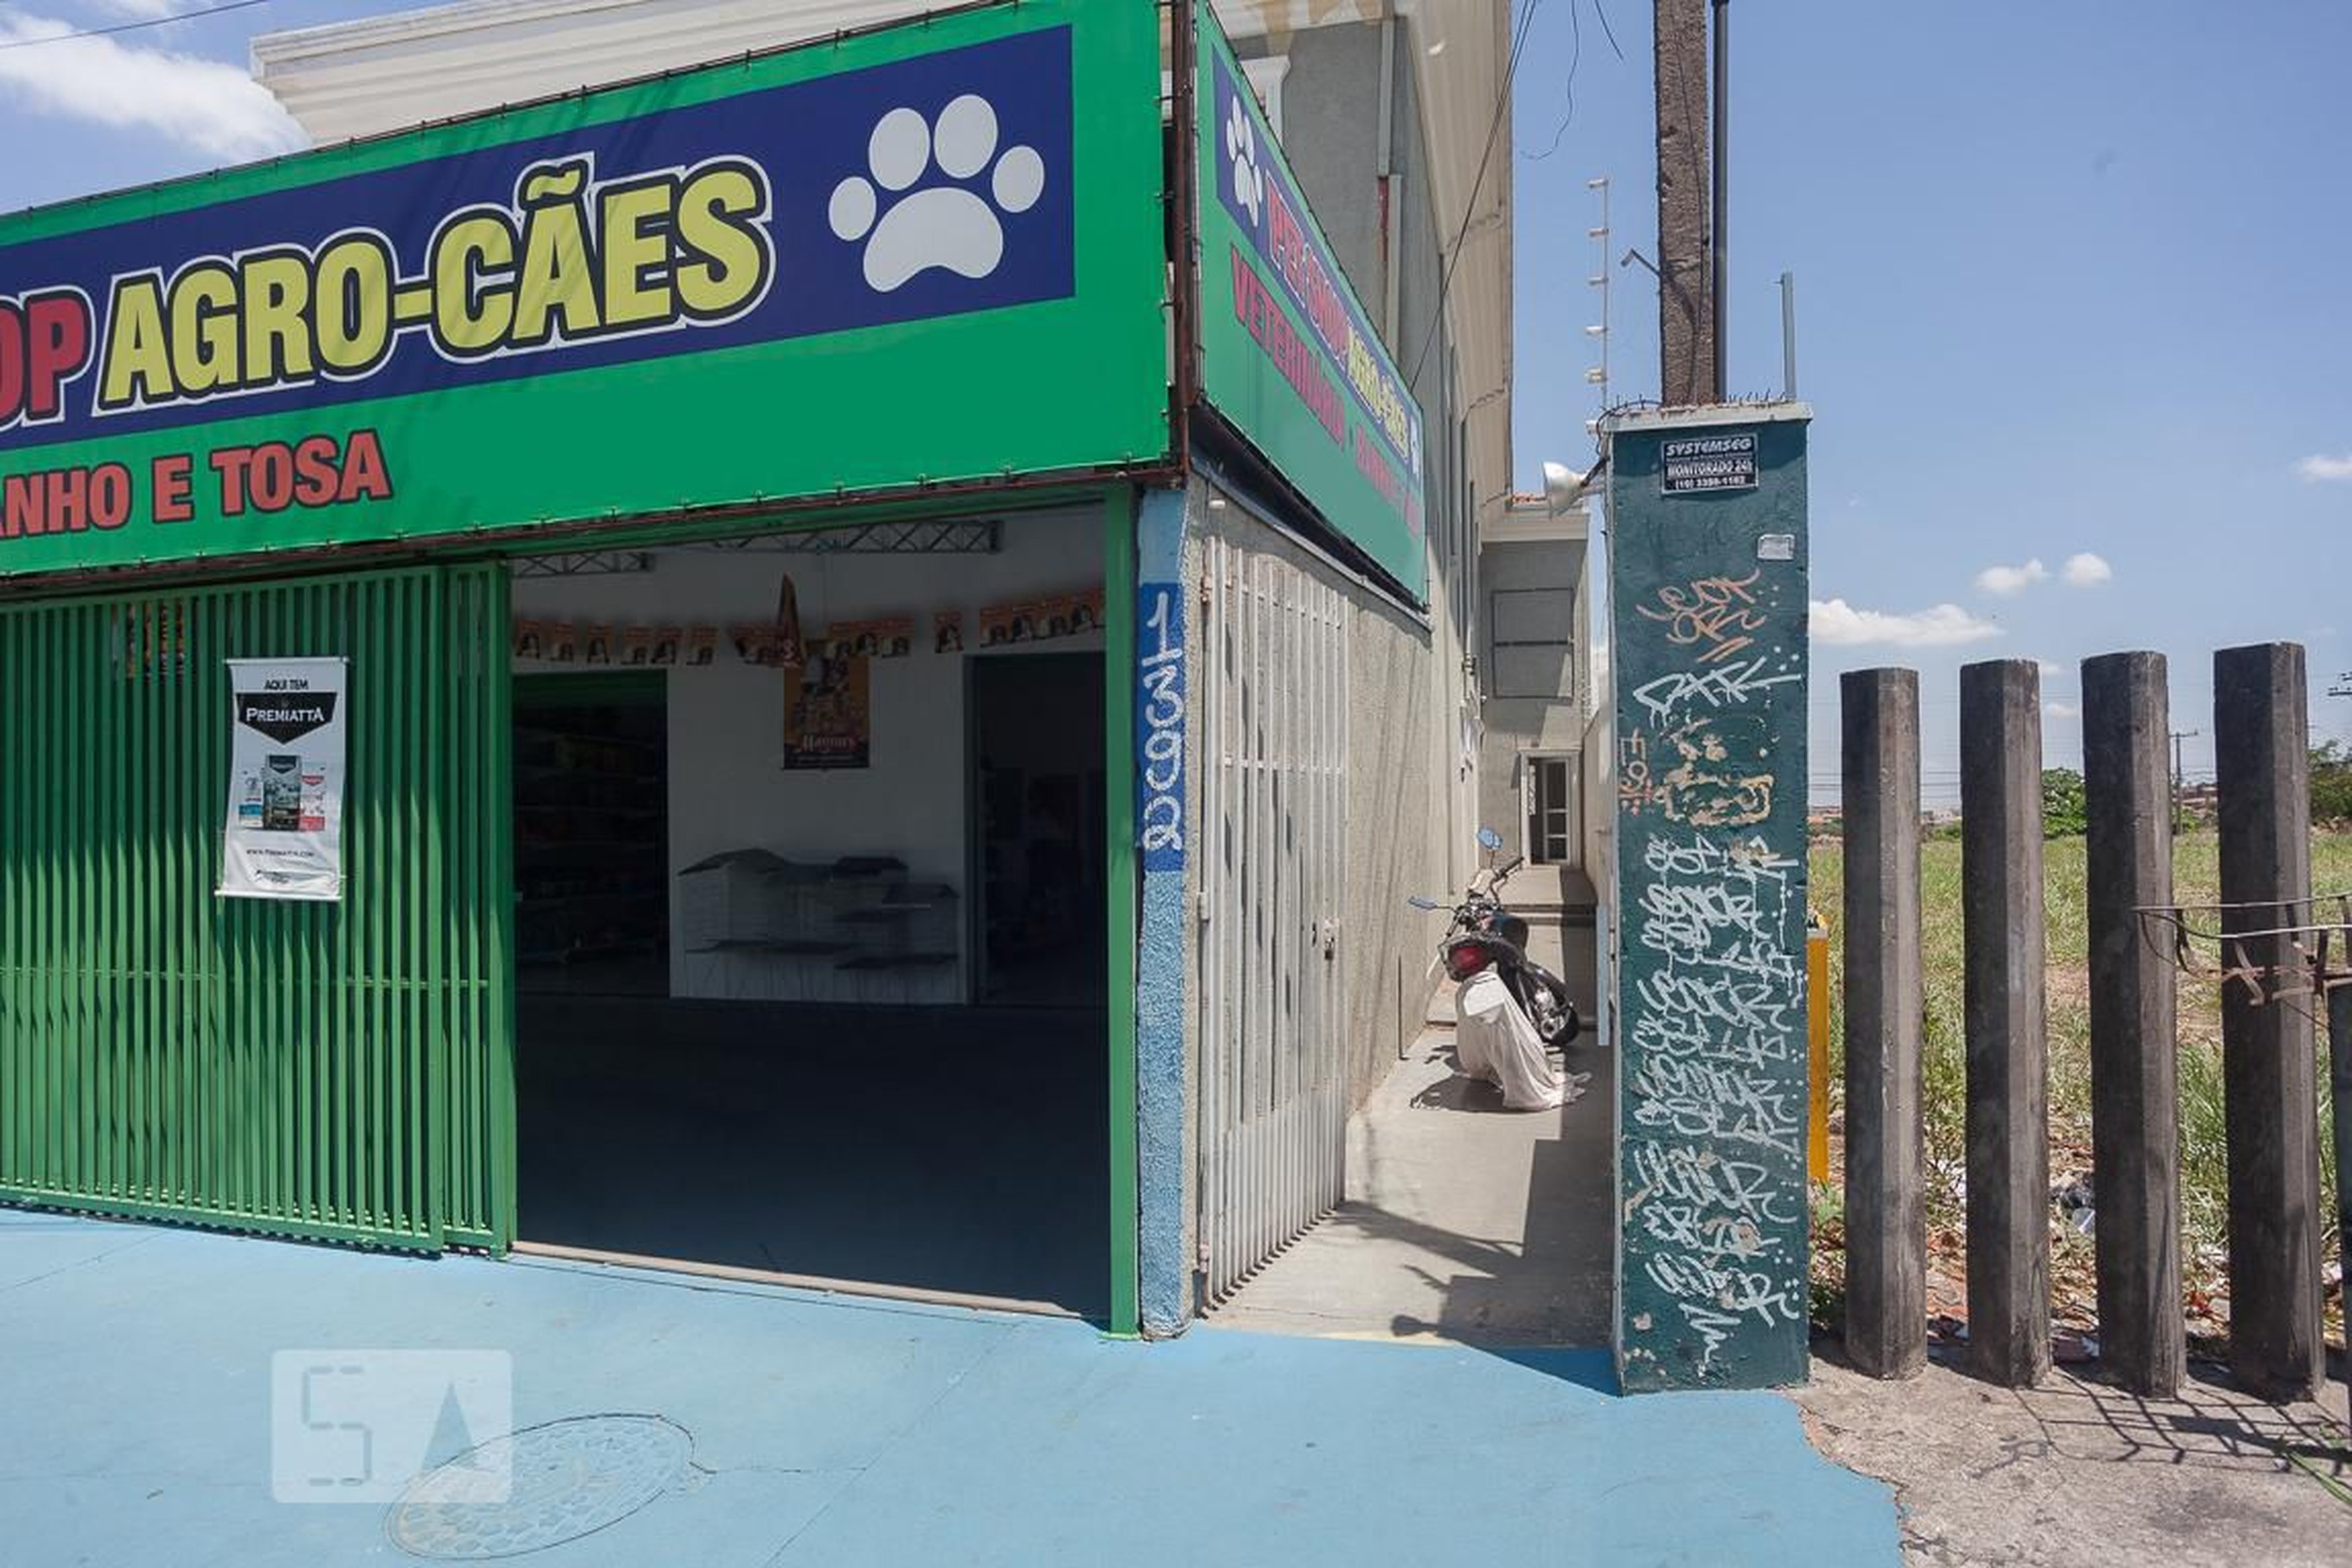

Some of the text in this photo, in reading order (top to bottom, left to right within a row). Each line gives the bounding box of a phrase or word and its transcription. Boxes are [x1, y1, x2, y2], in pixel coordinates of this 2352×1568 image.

[92, 151, 775, 418] AGRO-CÃES
[0, 429, 393, 541] NHO E TOSA
[264, 679, 309, 690] AQUI TEM
